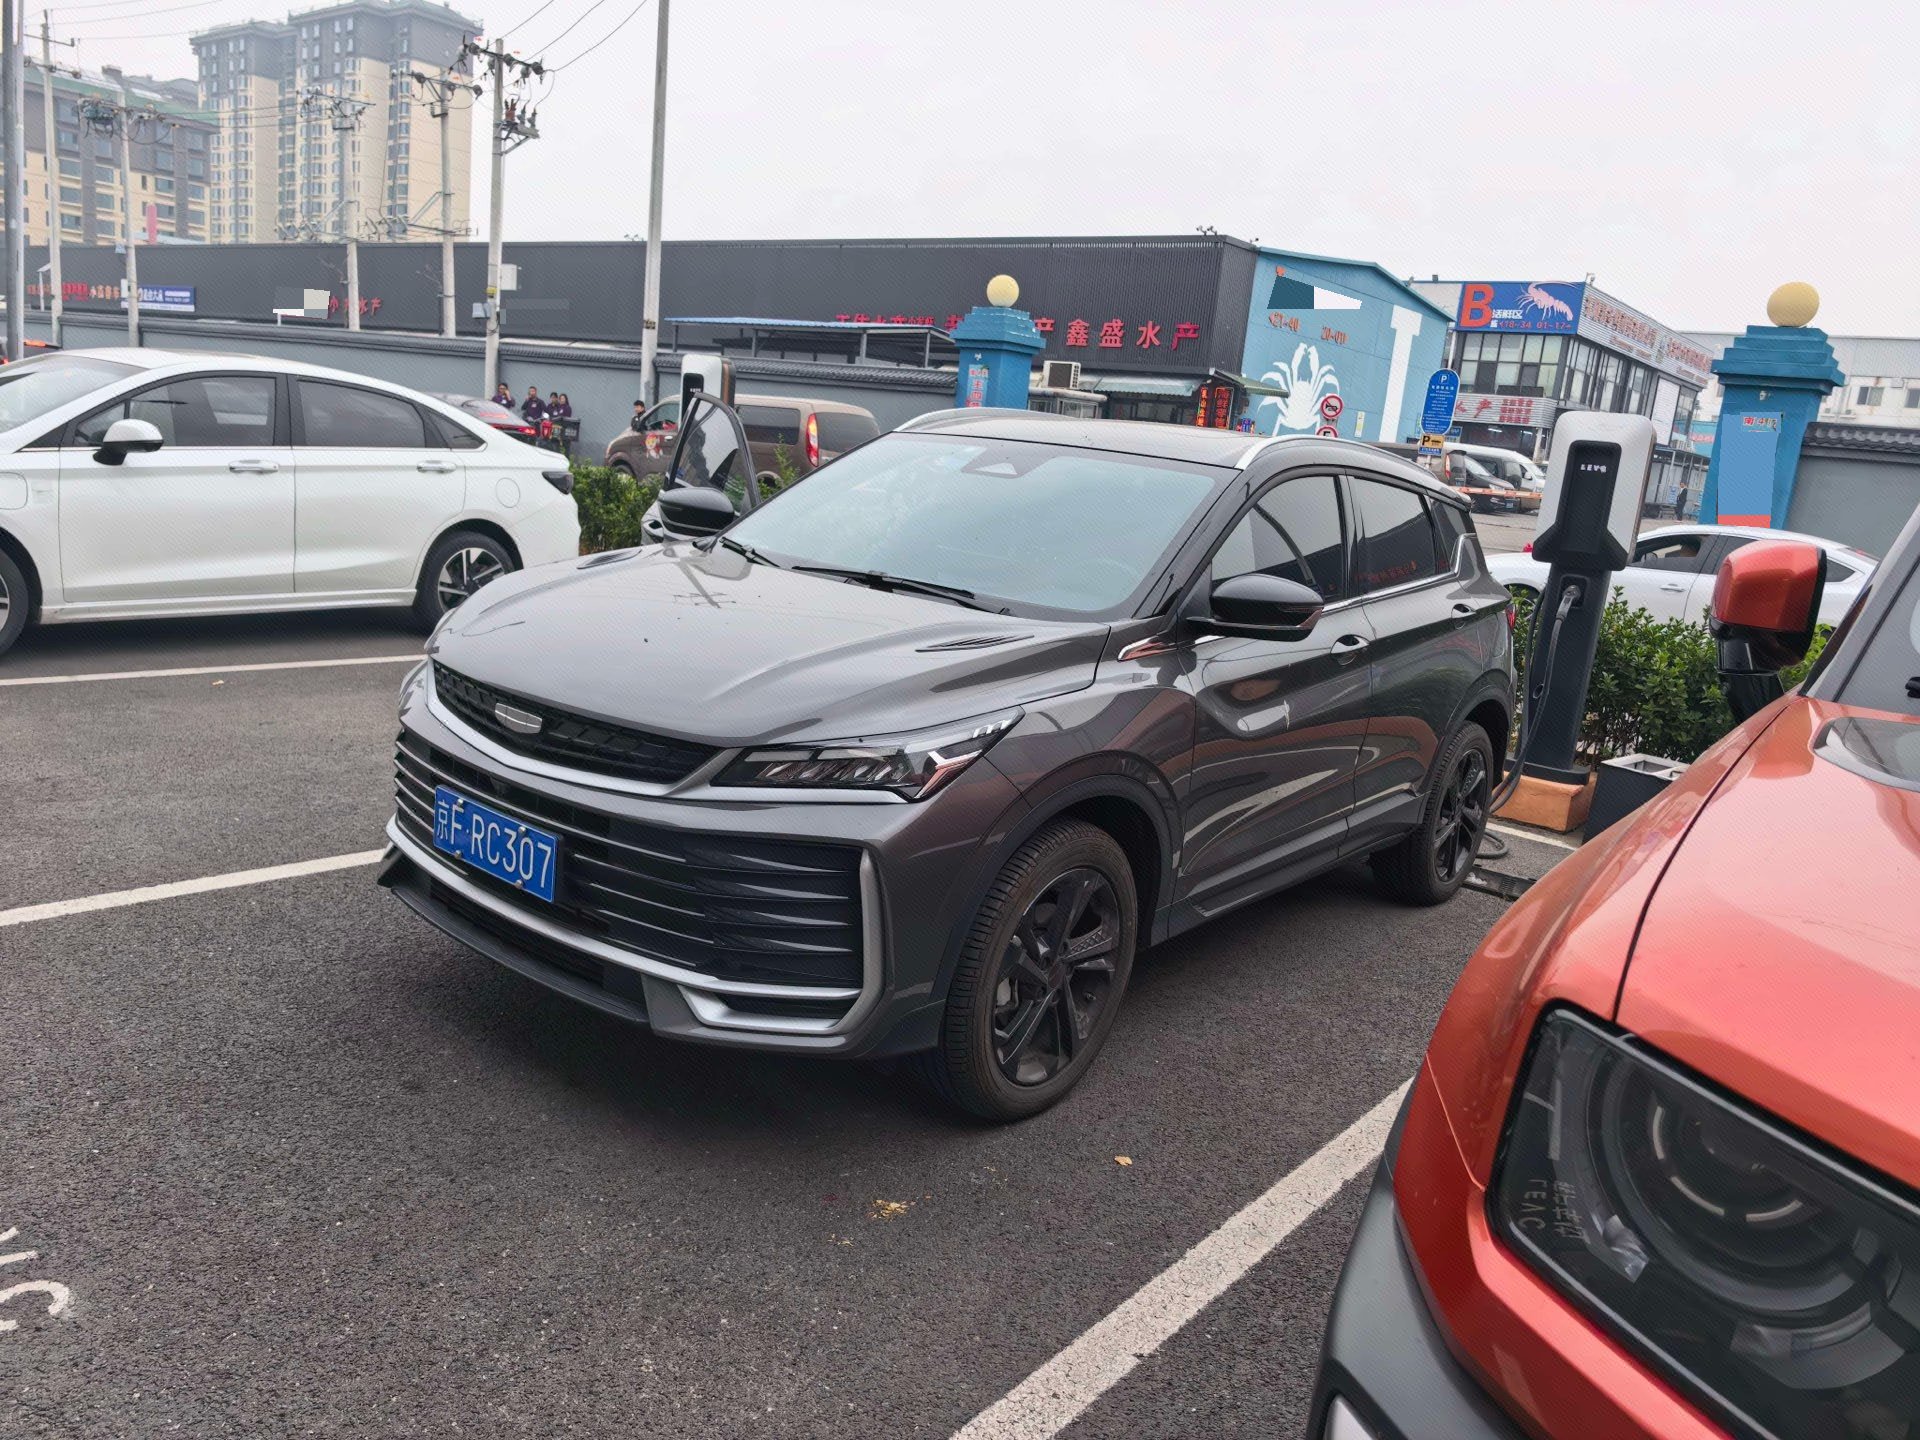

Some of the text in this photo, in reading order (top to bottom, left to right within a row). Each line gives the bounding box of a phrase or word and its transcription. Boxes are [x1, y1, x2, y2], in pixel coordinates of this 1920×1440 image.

[1460, 283, 1494, 328] B
[1066, 318, 1200, 351] 鑫盛水产
